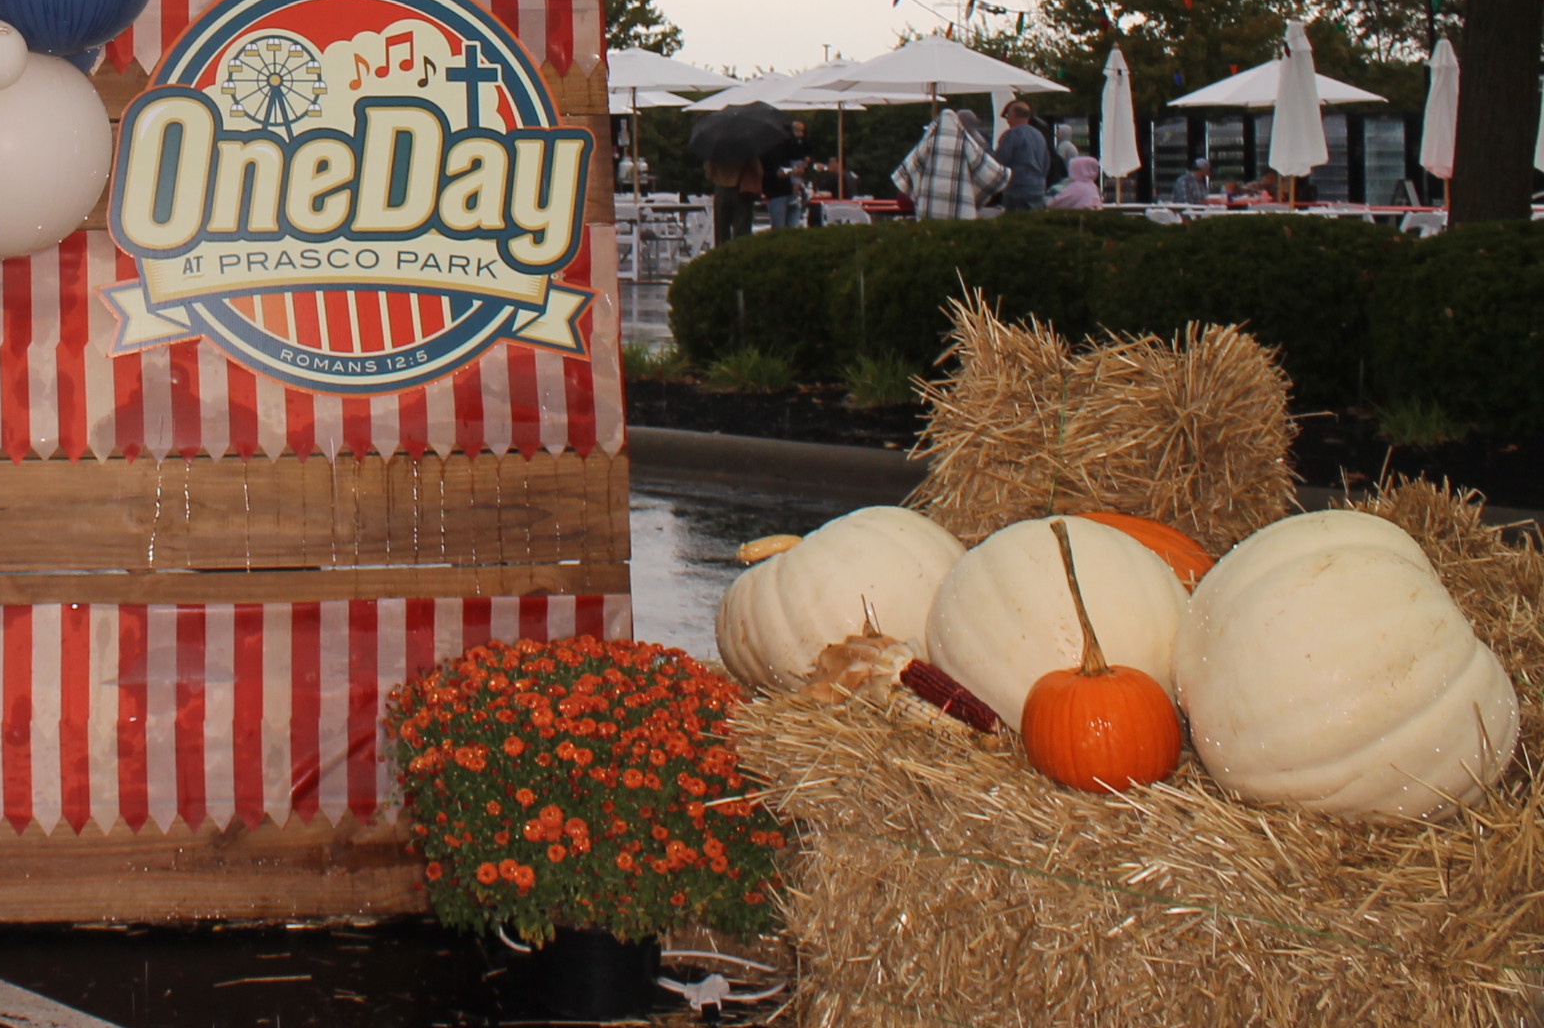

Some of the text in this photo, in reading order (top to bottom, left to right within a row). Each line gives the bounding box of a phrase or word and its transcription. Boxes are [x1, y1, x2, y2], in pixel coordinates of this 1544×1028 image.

[120, 96, 585, 266] OneDay
[182, 248, 499, 279] AT PRASCO PARK
[279, 349, 428, 373] ROMANS 12:5
